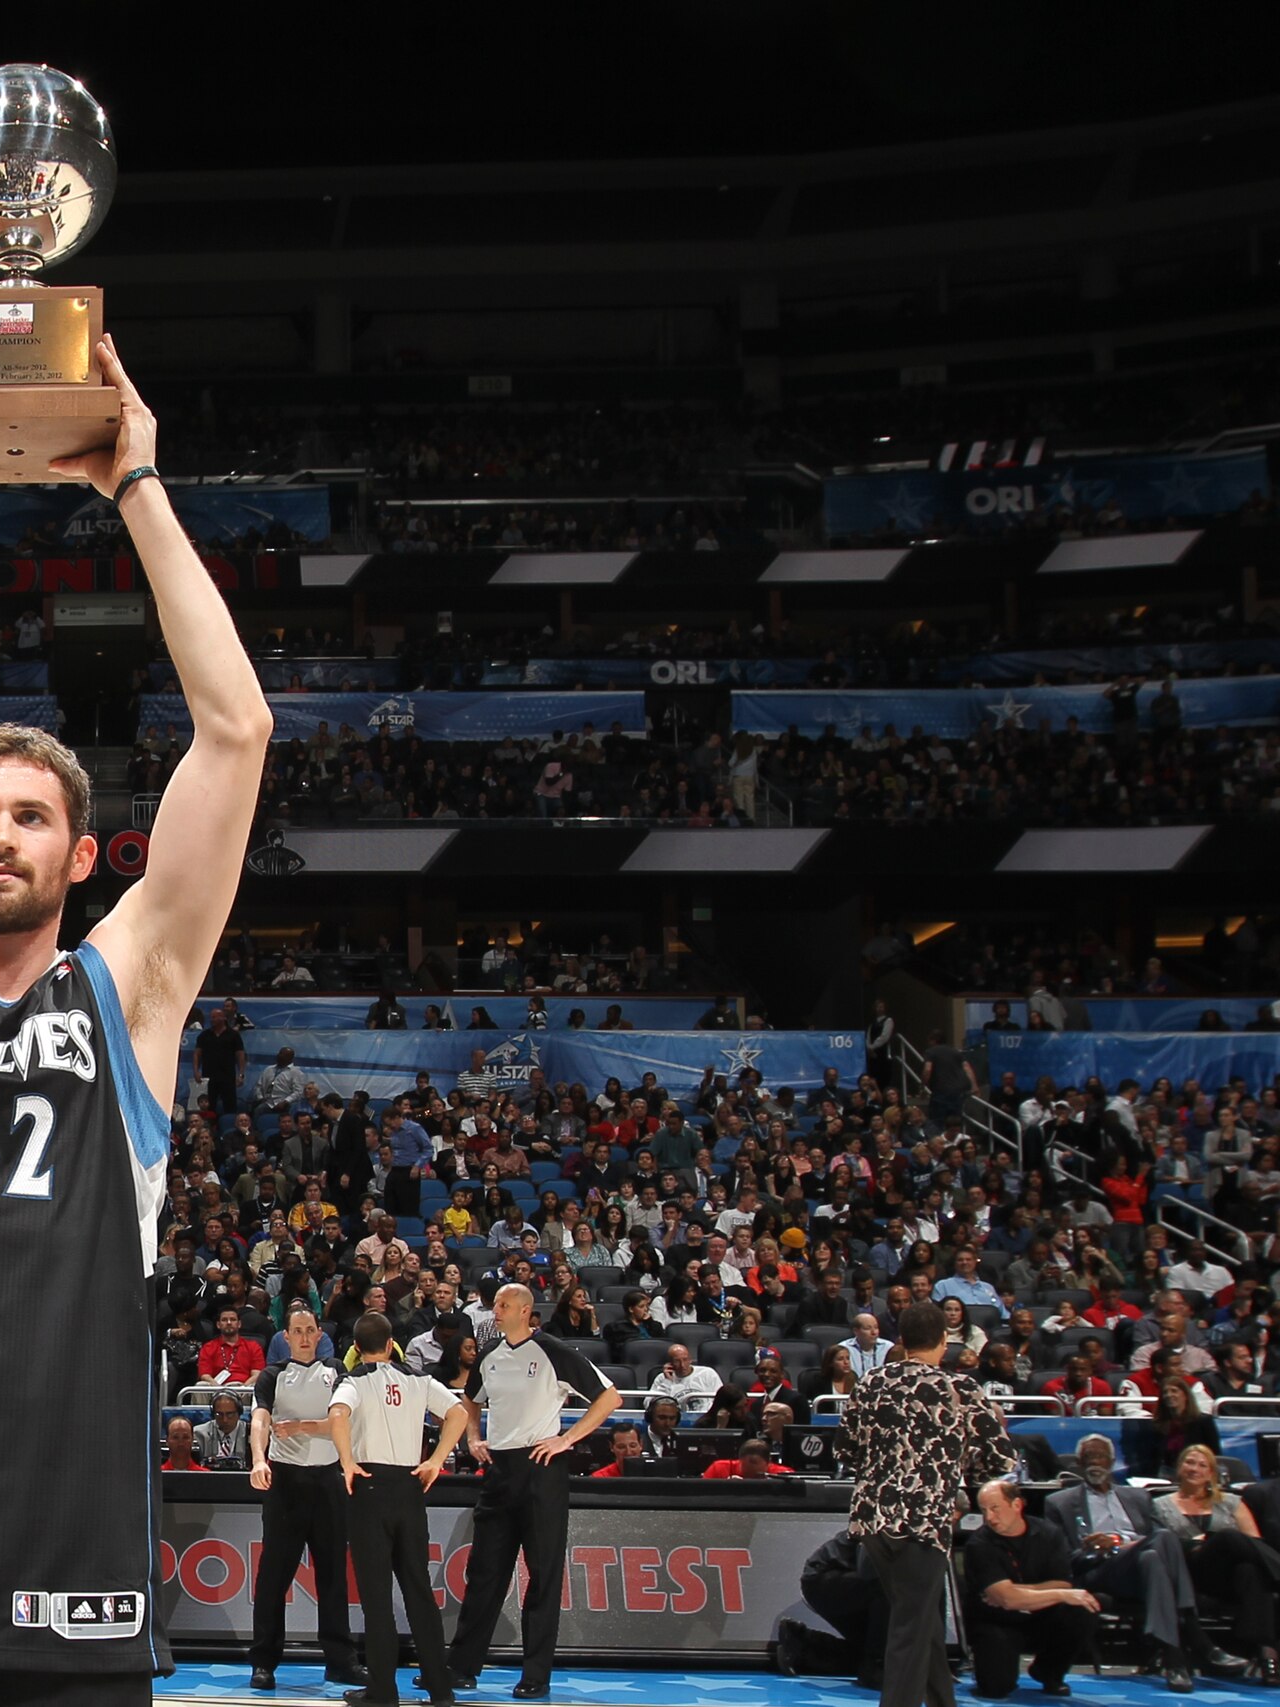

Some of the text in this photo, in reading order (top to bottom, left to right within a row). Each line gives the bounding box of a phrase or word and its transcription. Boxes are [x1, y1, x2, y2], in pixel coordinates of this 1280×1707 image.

[31, 363, 48, 371] 2012
[1, 372, 32, 381] February
[47, 371, 63, 380] 2012
[650, 660, 717, 685] ORL
[828, 1035, 853, 1049] 106
[999, 1035, 1024, 1049] 107
[385, 1384, 402, 1407] 35
[803, 1437, 822, 1457] hp
[117, 1604, 134, 1613] 3XL
[71, 1612, 97, 1620] adidas
